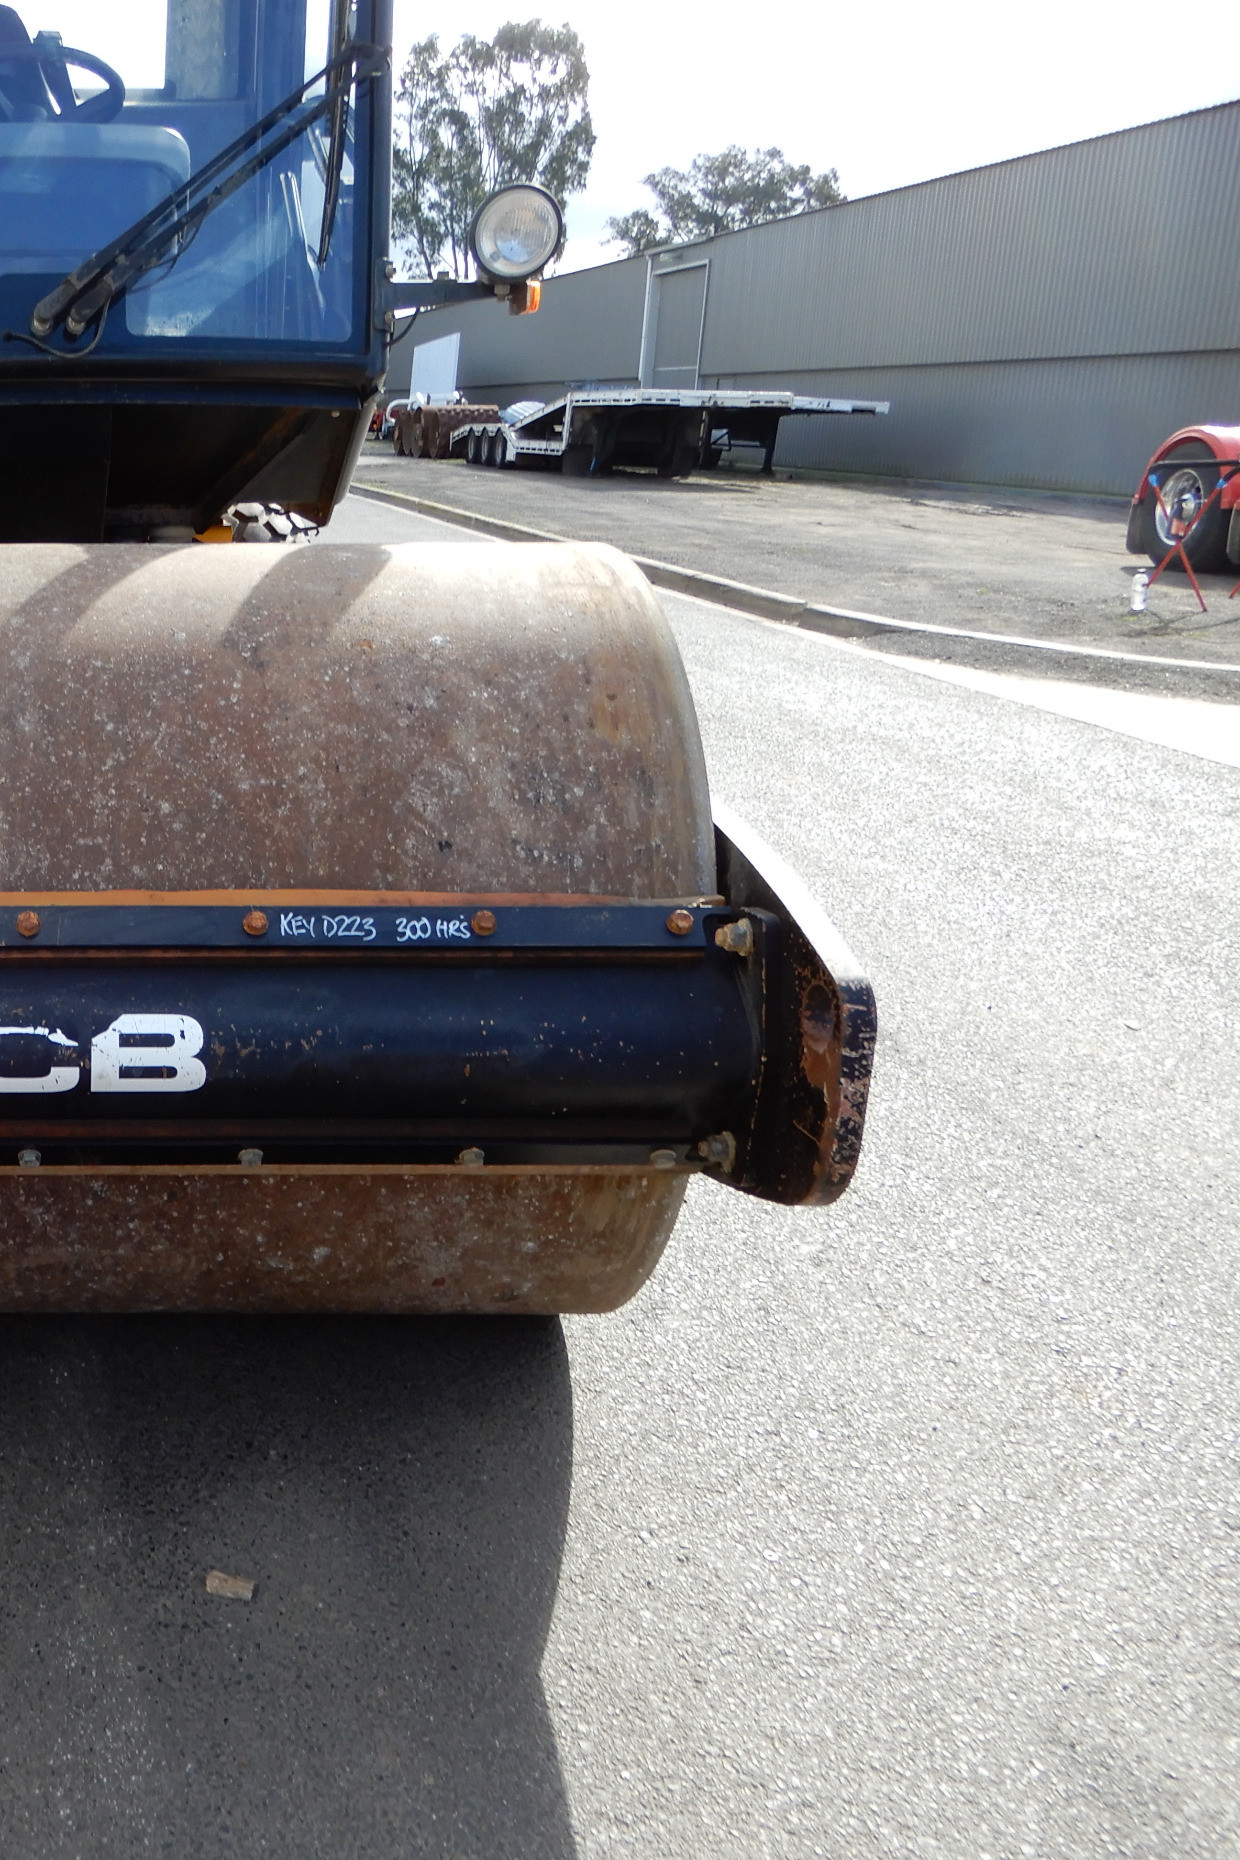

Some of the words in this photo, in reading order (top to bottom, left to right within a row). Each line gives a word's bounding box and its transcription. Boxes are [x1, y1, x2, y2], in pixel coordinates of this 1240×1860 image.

[280, 912, 315, 938] KEY
[321, 914, 377, 941] D223
[395, 916, 432, 942] 300
